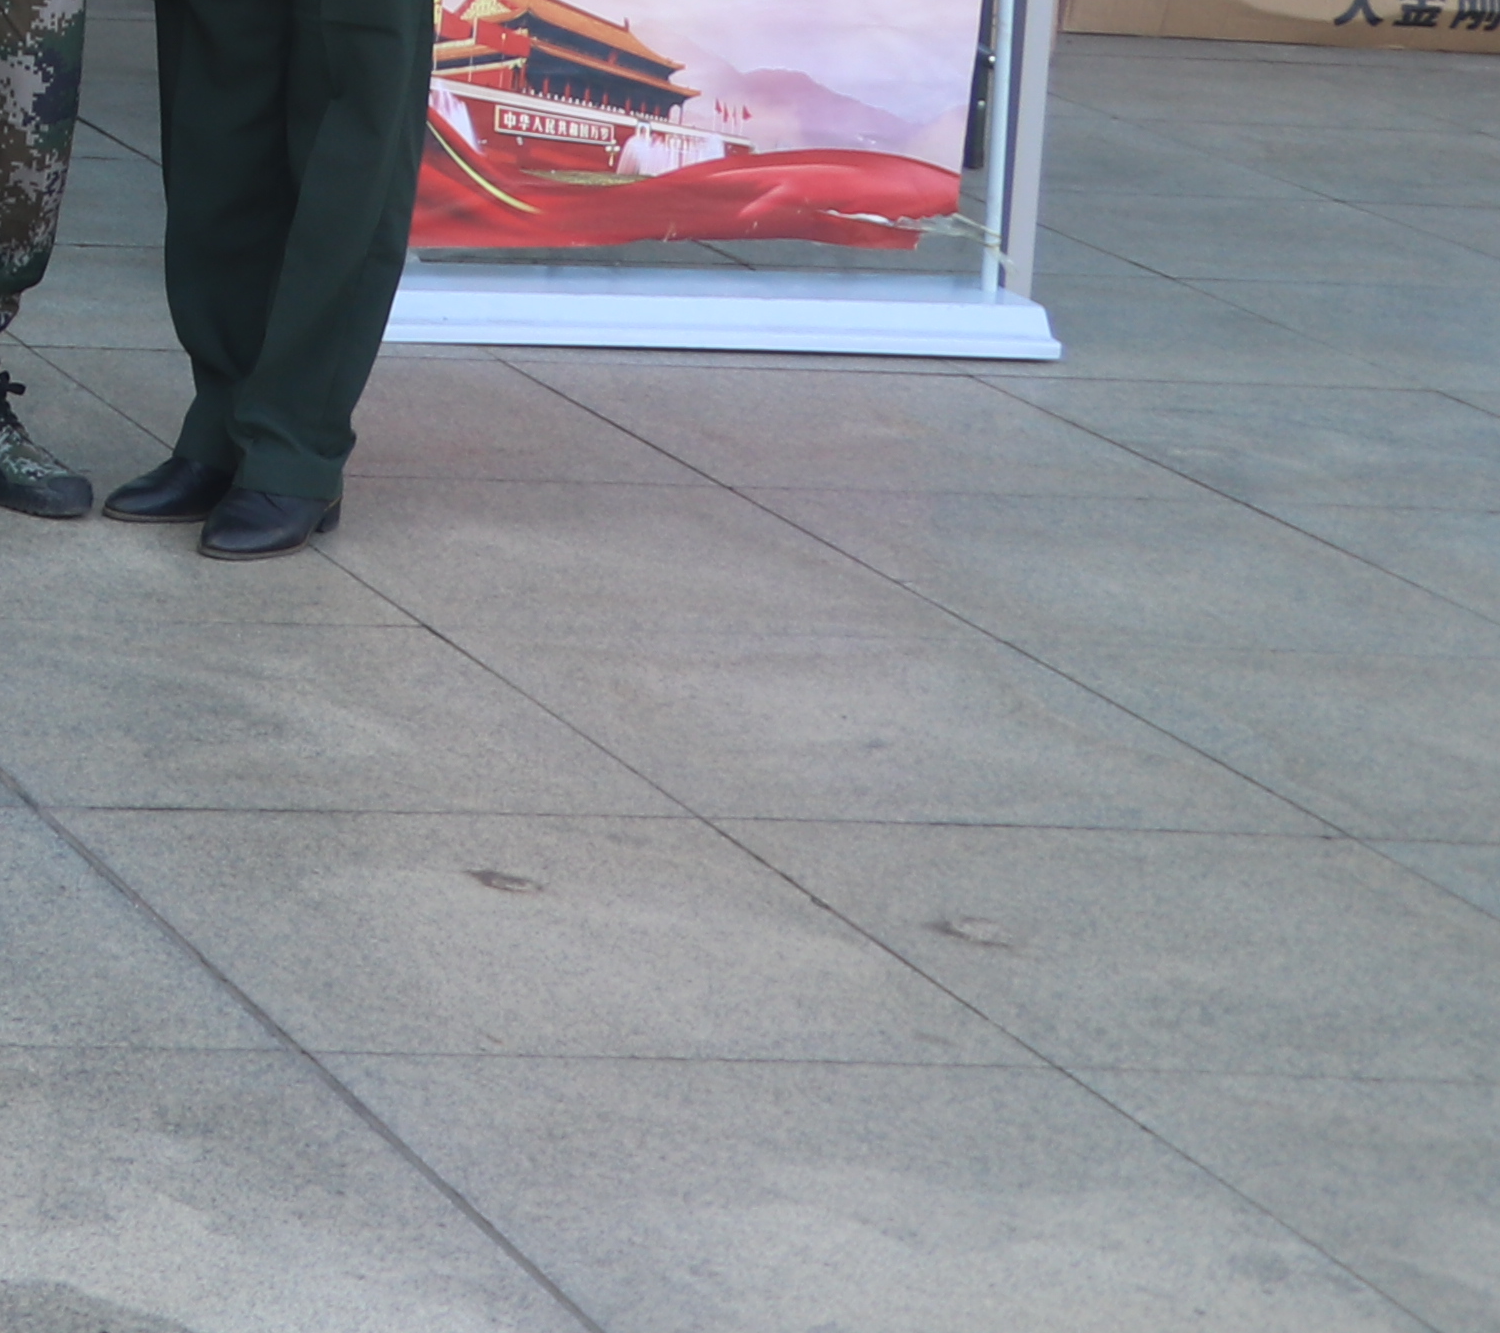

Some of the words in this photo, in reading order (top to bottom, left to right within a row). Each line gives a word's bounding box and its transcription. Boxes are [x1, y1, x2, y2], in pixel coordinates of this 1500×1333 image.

[503, 111, 611, 141] 中华人民共和国万岁
